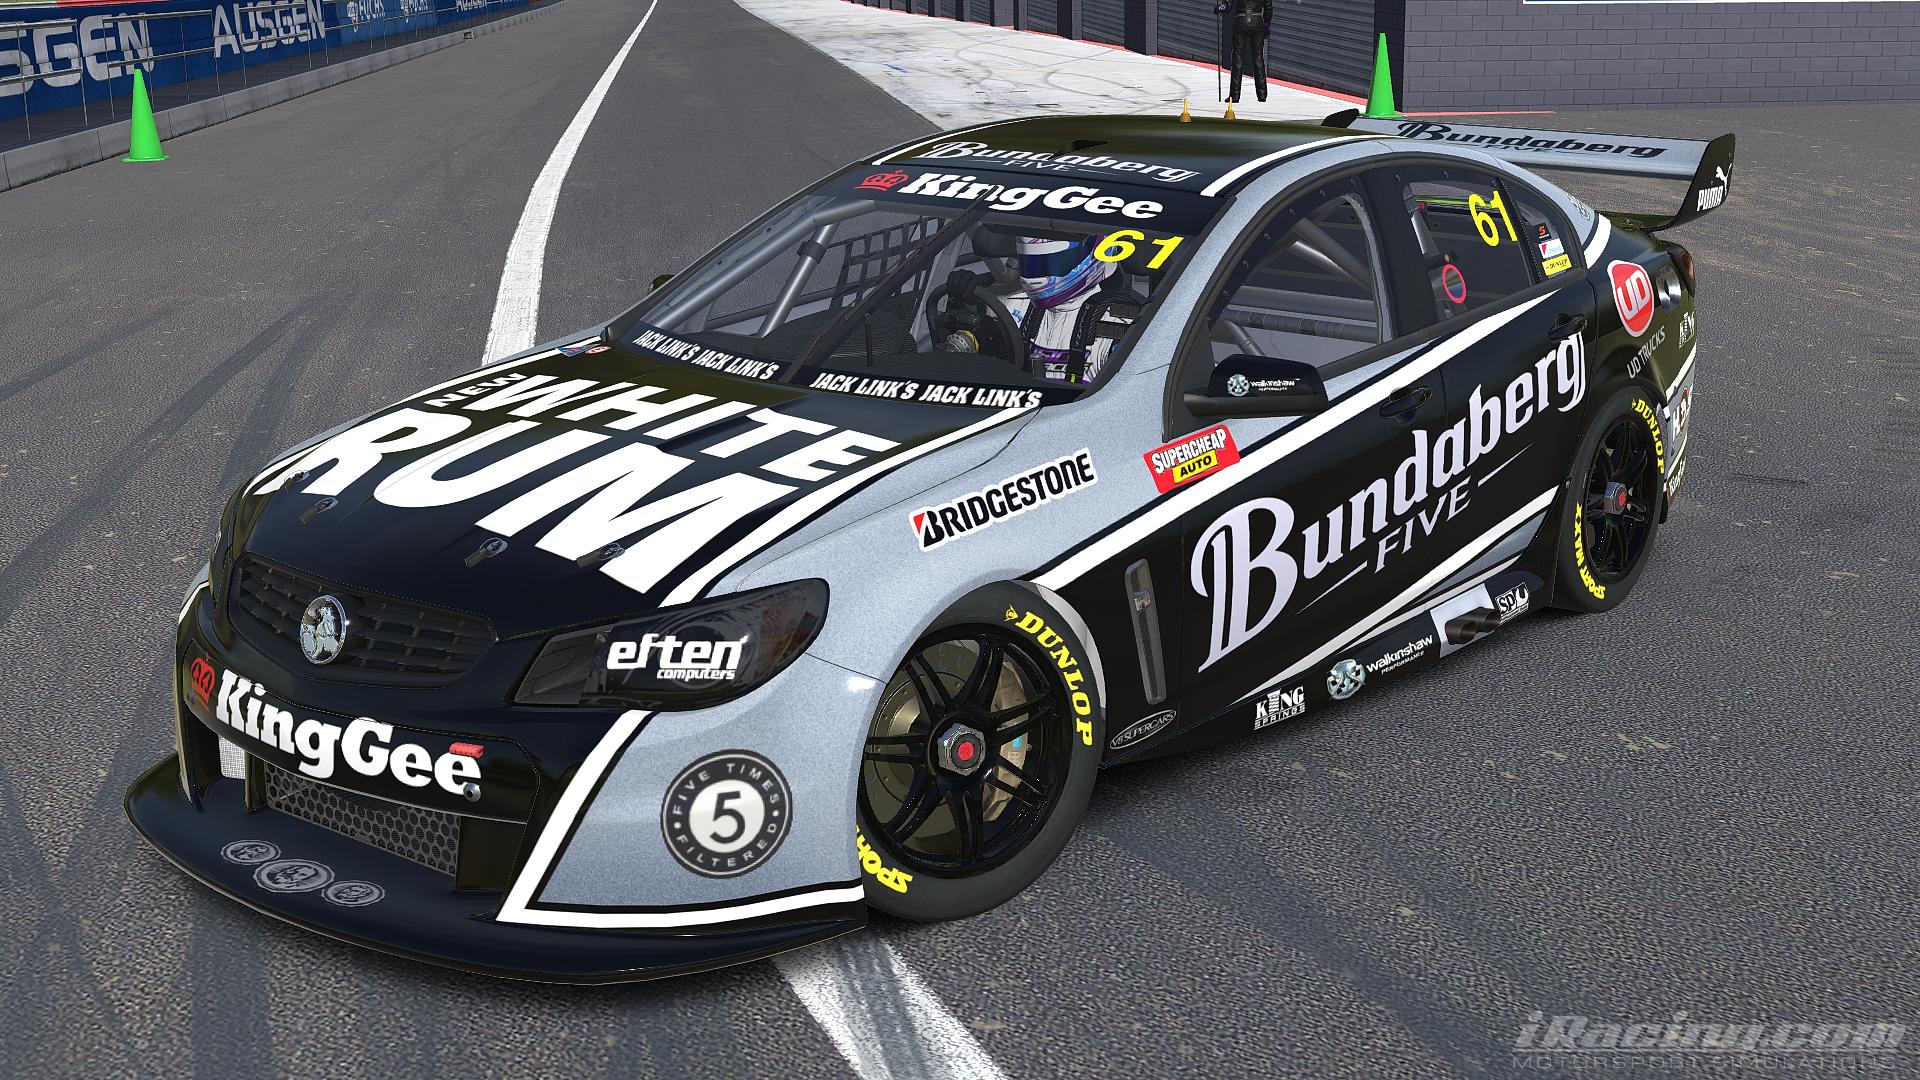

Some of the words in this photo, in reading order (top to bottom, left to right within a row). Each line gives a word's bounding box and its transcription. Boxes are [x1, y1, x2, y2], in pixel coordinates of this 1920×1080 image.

[213, 0, 326, 58] AUSGEN
[911, 141, 1201, 183] Bundaberg
[1398, 122, 1668, 158] Bundaberg
[1009, 159, 1072, 173] FIVE
[899, 172, 1164, 219] KingGee
[1468, 191, 1518, 247] 61
[1697, 186, 1724, 212] PUMA
[1093, 230, 1185, 270] 61
[1616, 269, 1651, 321] UD
[633, 329, 659, 349] JACK
[657, 335, 700, 362] LINK'S
[697, 347, 731, 374] JACK
[727, 356, 780, 380] LINK'S
[1627, 358, 1641, 379] UD
[1639, 325, 1666, 361] TRUCKS
[430, 372, 530, 409] NEW
[809, 372, 858, 394] JACK
[857, 377, 920, 400] LINK'S
[919, 384, 971, 406] JACK
[971, 388, 1043, 409] LINK'S
[500, 375, 909, 482] WHITE
[1151, 428, 1228, 475] SUPERCHEAP
[1634, 398, 1665, 475] DUNLOP
[1179, 455, 1213, 479] AUTO
[253, 408, 800, 595] RUM
[913, 452, 1095, 548] BRIDGESTONE
[1189, 333, 1588, 673] Bundaberg
[1374, 476, 1472, 574] FIVE
[1574, 501, 1585, 566] MAXX
[656, 668, 735, 682] computers
[1366, 634, 1434, 673] walkinshaw
[1014, 611, 1093, 746] DUNLOP
[216, 669, 482, 796] KingGee
[1123, 712, 1174, 742] SUPERCARS
[672, 770, 711, 815] FIVE
[726, 762, 780, 804] TIMES
[709, 790, 746, 845] 5
[676, 823, 777, 868] FILTERED
